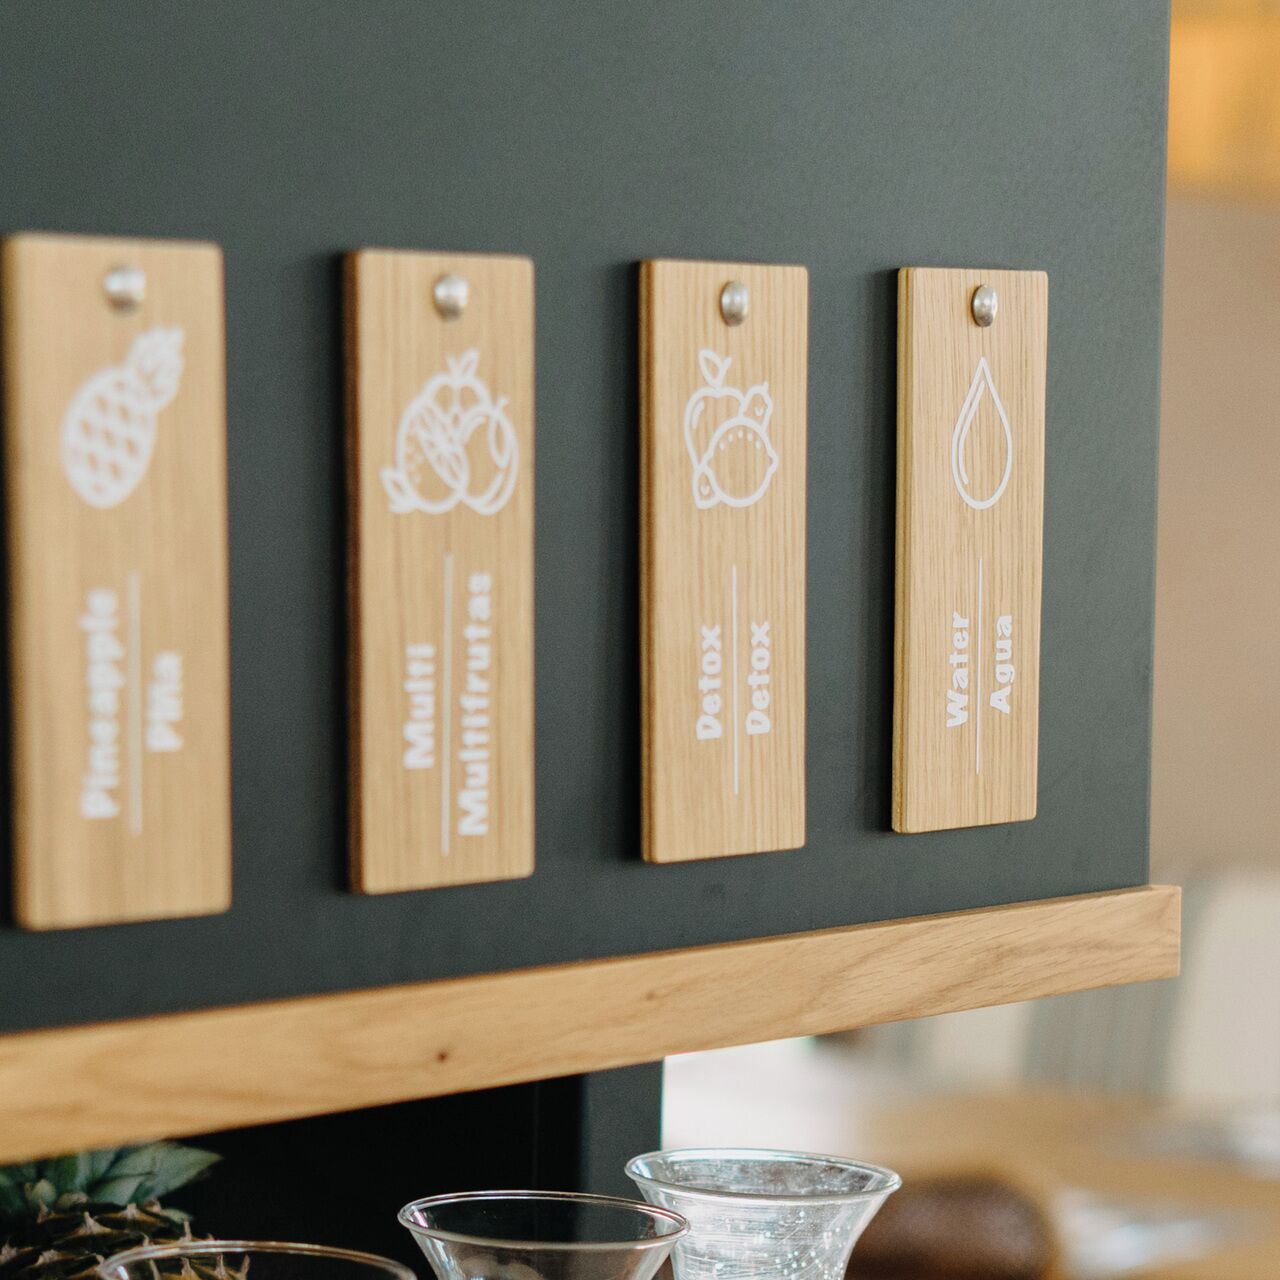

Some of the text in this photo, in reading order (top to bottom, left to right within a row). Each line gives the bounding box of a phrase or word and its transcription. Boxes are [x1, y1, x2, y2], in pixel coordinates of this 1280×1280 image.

[80, 589, 124, 819] Pineapple
[403, 643, 436, 770] Multi
[457, 572, 492, 836] Multifrutas
[695, 624, 722, 741] Detox
[745, 620, 771, 736] Detox
[946, 612, 970, 729] Water
[989, 614, 1015, 715] Agua
